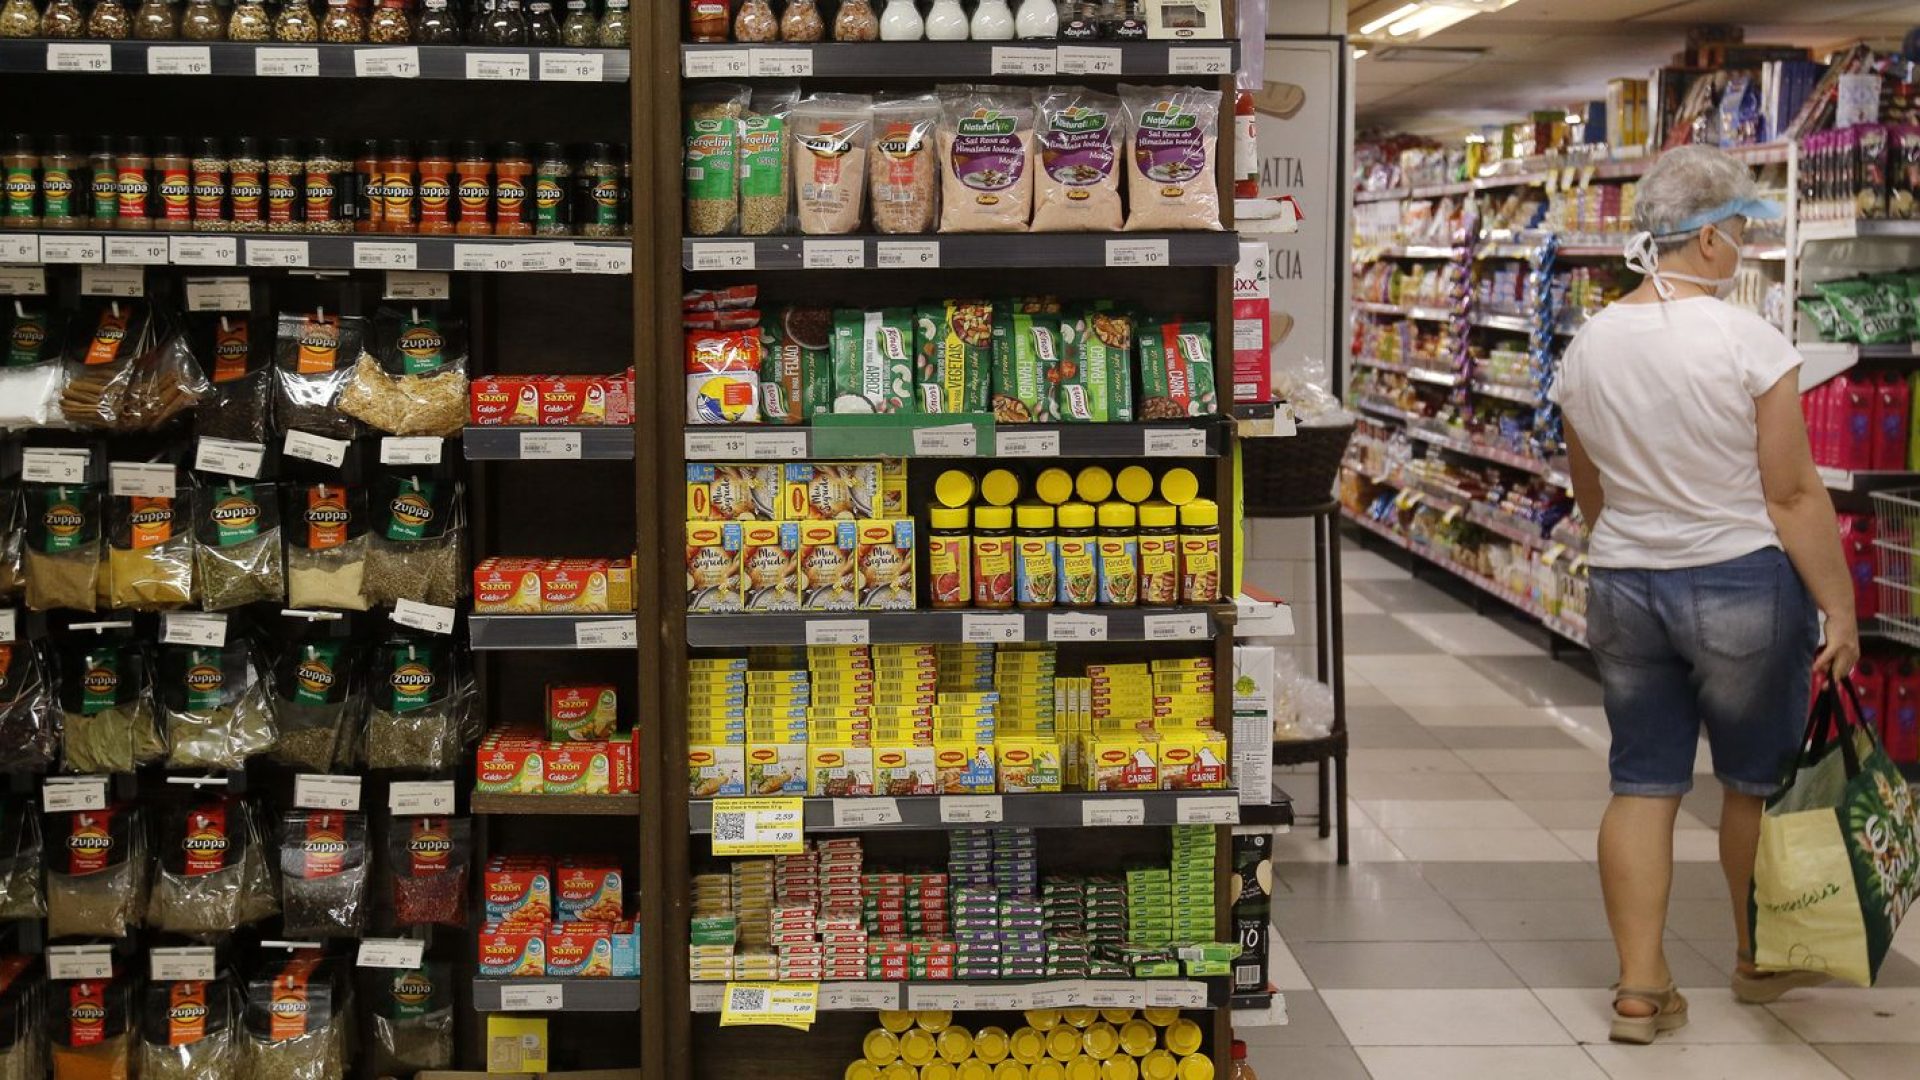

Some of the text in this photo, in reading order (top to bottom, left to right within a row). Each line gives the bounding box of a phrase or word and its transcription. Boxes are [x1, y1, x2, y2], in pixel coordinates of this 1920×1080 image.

[1071, 132, 1100, 142] Rosa do
[1148, 129, 1192, 139] Sal Rosa do
[979, 136, 996, 145] Rosa
[999, 136, 1010, 145] do
[1257, 157, 1304, 188] ATTA
[402, 338, 441, 349] zuppa
[948, 343, 964, 388] VEGETAIS
[866, 365, 880, 395] ARROZ
[1170, 370, 1186, 398] CARNE
[478, 392, 508, 402] Sazón
[544, 392, 576, 402] Sazón
[215, 507, 256, 519] zuppa
[393, 500, 430, 519] zuppa
[131, 511, 171, 524] zuppa
[309, 512, 348, 521] zuppa
[299, 670, 333, 683] zuppa
[394, 675, 432, 684] zuppa
[484, 762, 515, 771] Sazón
[550, 762, 580, 771] Sazón
[1127, 775, 1153, 783] CARNE
[1192, 774, 1217, 783] CARNE
[71, 837, 109, 849] zuppa
[187, 839, 225, 850] zuppa
[305, 842, 344, 853] zuppa
[411, 840, 450, 851] zuppa
[171, 1007, 205, 1018] zuppa
[272, 1003, 306, 1012] zuppa
